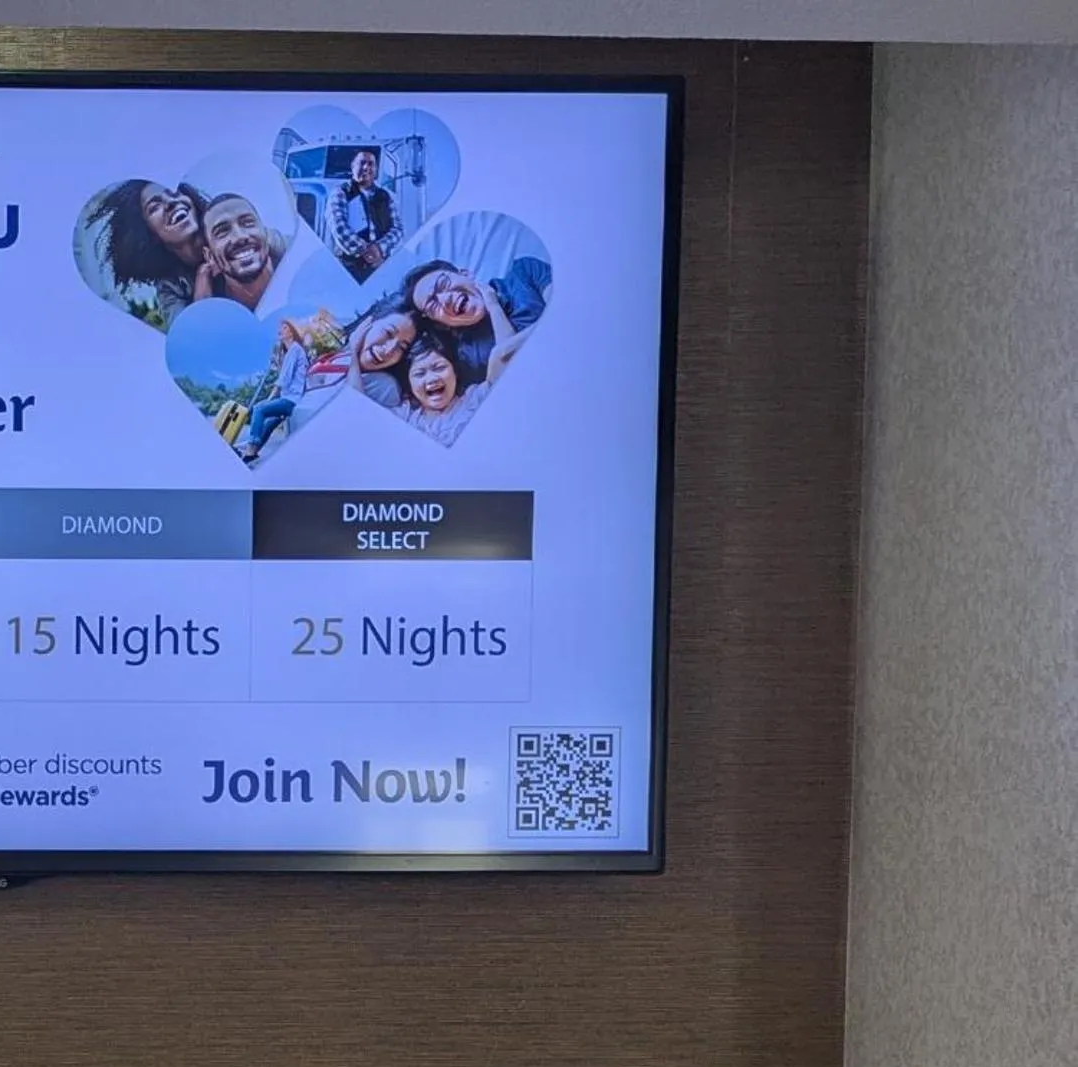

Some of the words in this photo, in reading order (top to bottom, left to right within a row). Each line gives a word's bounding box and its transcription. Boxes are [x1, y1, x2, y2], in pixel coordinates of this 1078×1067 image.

[343, 504, 443, 521] DIAMOND
[63, 516, 162, 534] DIAMOND
[358, 531, 429, 549] SELECT
[8, 617, 55, 654] 15
[76, 615, 219, 666] Nights
[292, 618, 343, 655] 25
[362, 615, 506, 666] Nights
[45, 754, 161, 774] discounts
[202, 758, 313, 803] Join
[331, 758, 466, 803] Now!
